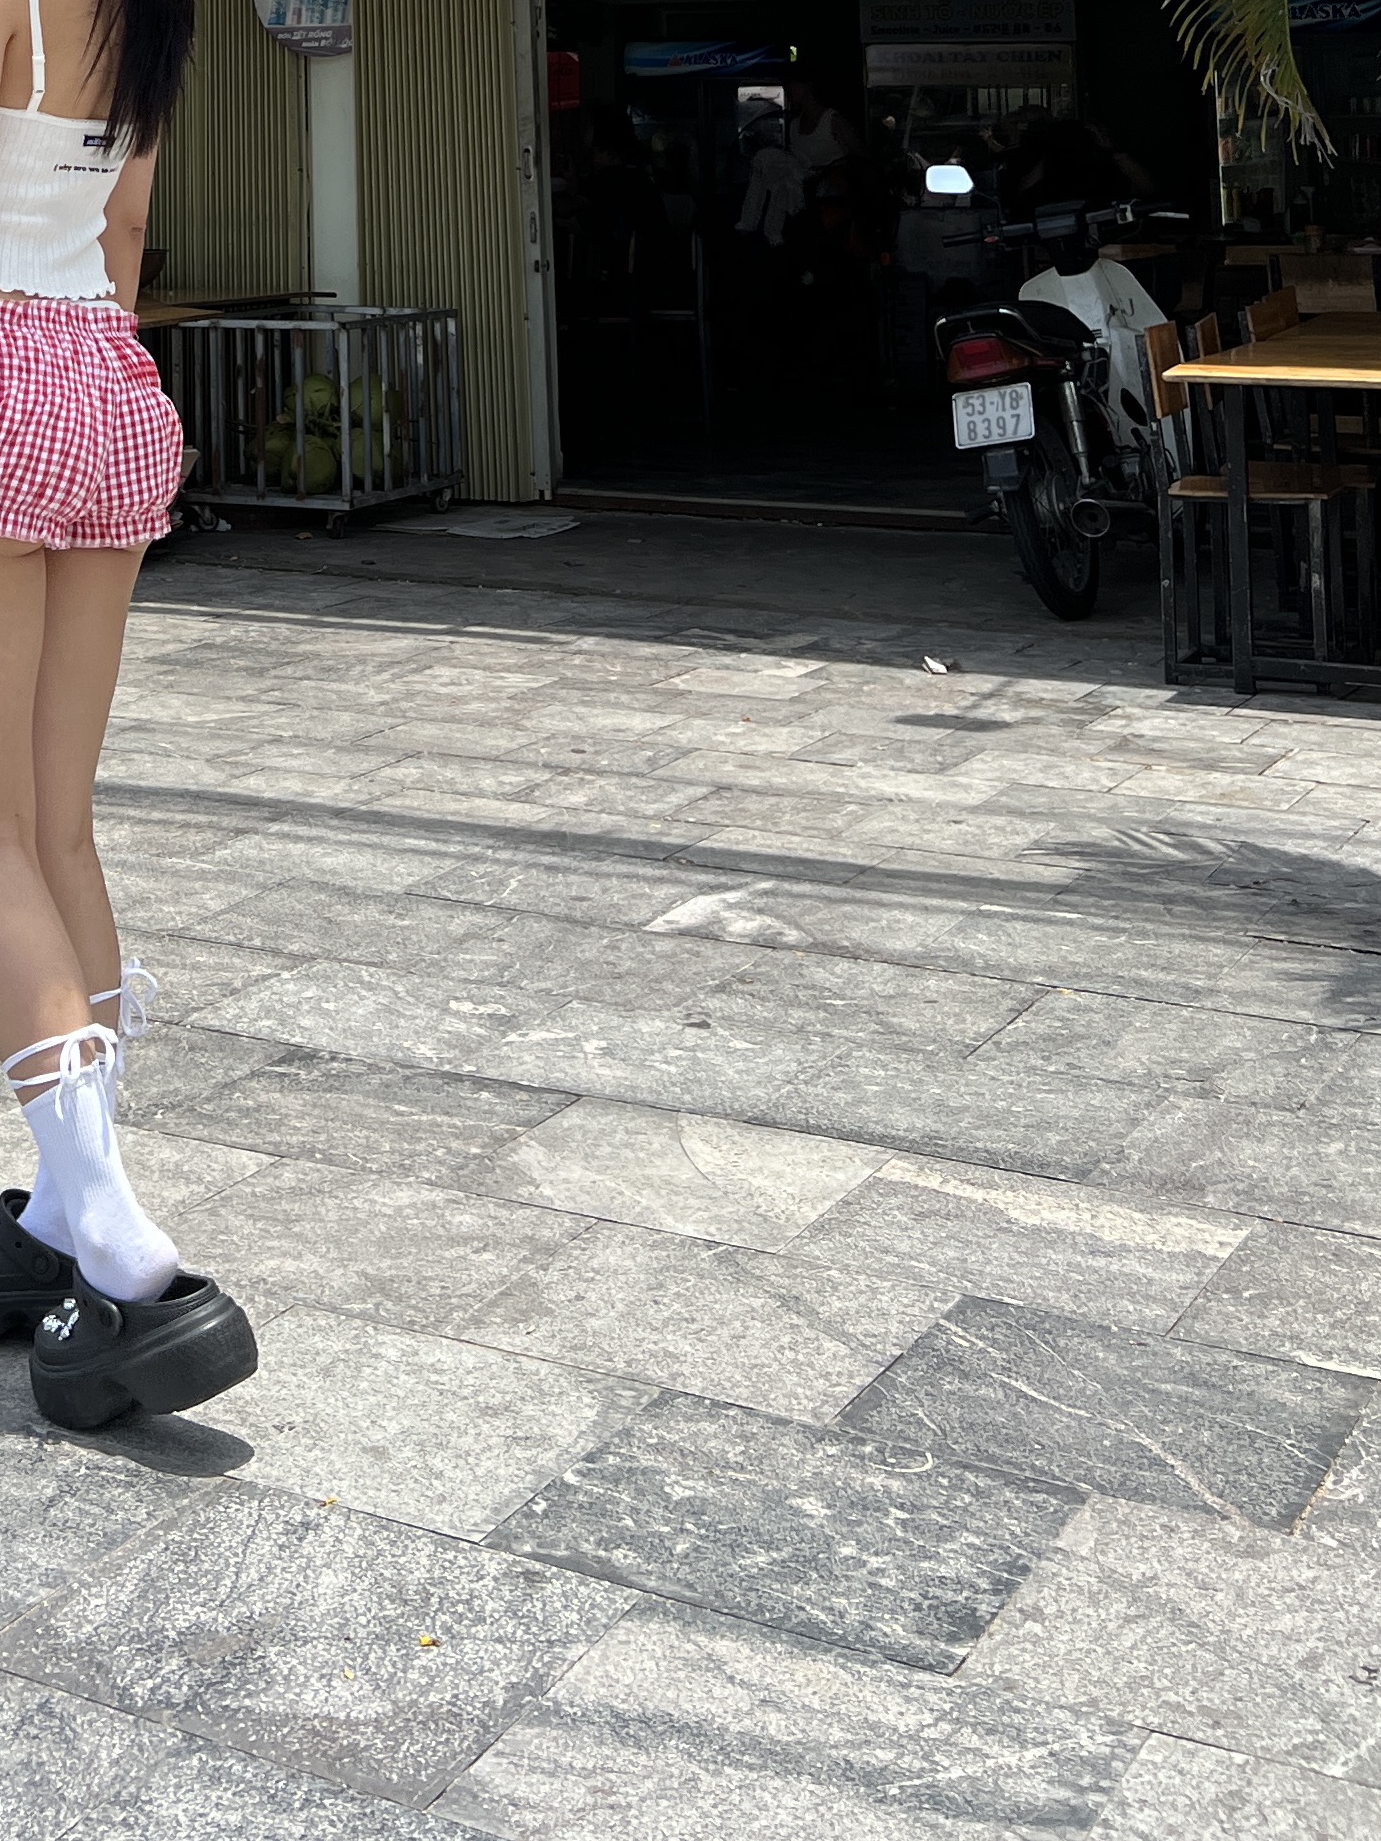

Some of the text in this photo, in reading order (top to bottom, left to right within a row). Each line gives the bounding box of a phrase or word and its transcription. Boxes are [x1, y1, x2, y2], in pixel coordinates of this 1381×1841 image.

[1287, 1, 1364, 21] LASKA
[683, 52, 739, 67] ALASKA
[966, 413, 1021, 442] 8397
